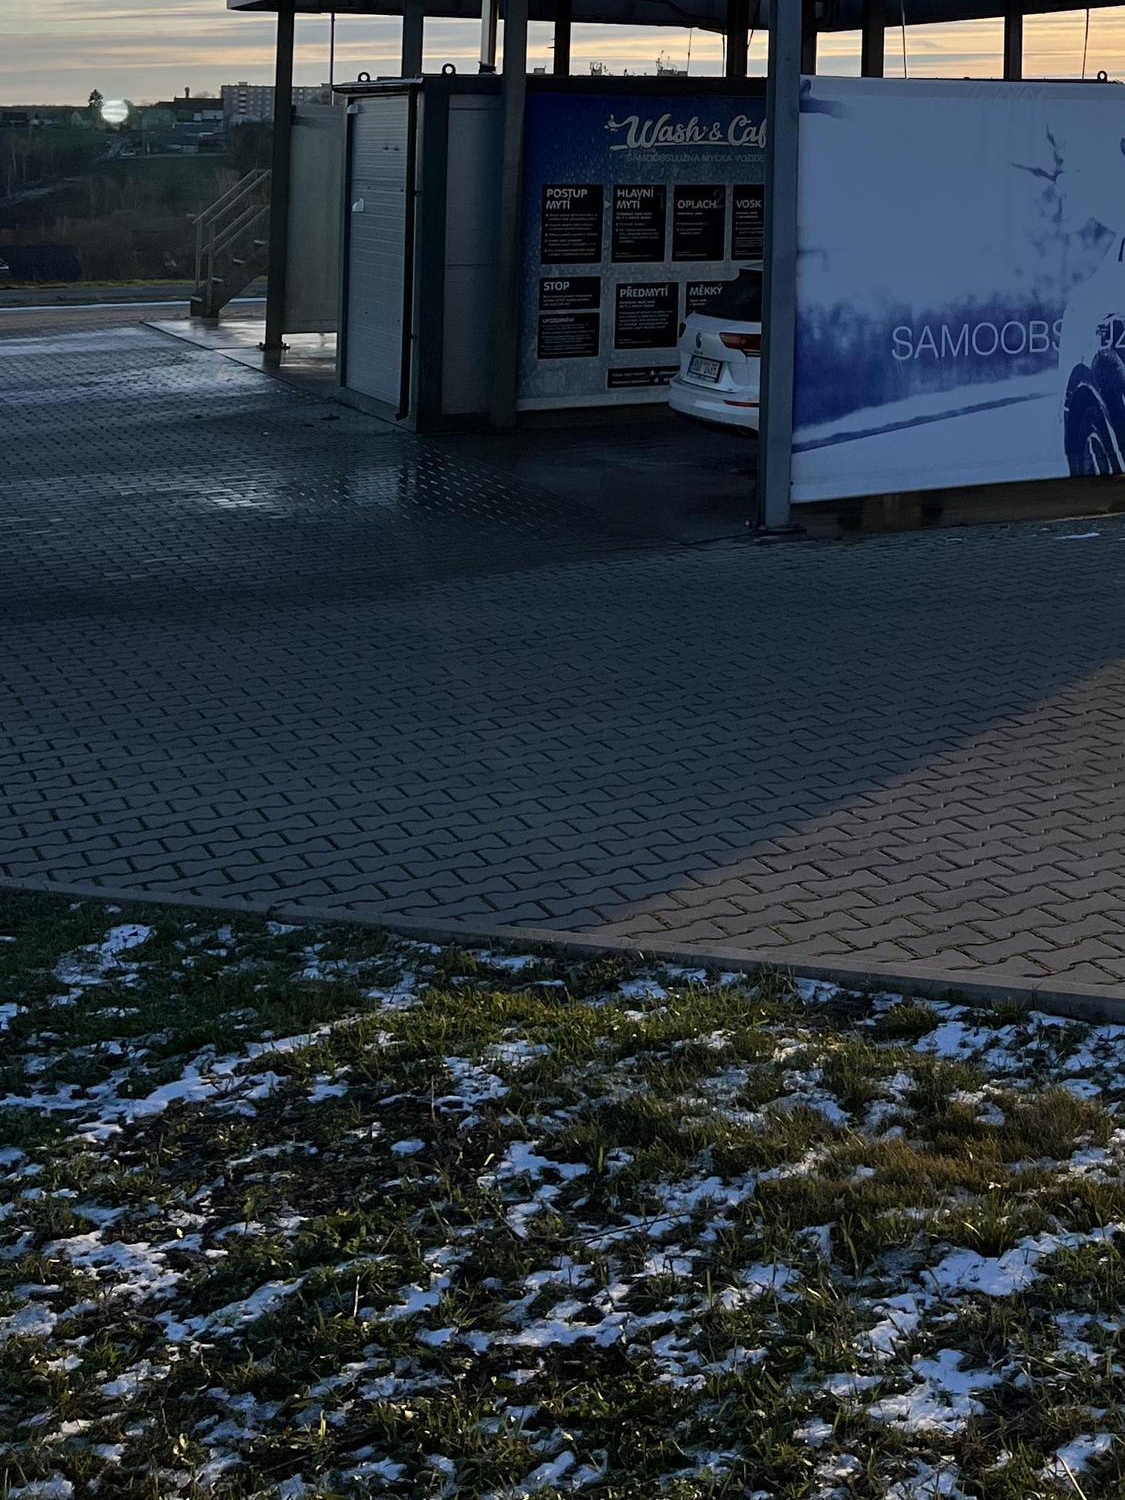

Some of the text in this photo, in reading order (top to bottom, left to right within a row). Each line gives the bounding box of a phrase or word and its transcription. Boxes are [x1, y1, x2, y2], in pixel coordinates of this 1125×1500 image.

[608, 113, 767, 148] Wash & Caf
[546, 188, 588, 198] POSTUP
[616, 187, 655, 198] HLAVNÍ
[545, 198, 571, 210] MYTÍ
[616, 198, 641, 210] MYTÍ
[677, 199, 717, 209] OPLACH
[736, 199, 763, 209] VOSK
[543, 281, 570, 291] STOP
[619, 285, 669, 298] PŘEDMYTÍ
[689, 284, 723, 296] MĚKKÝ
